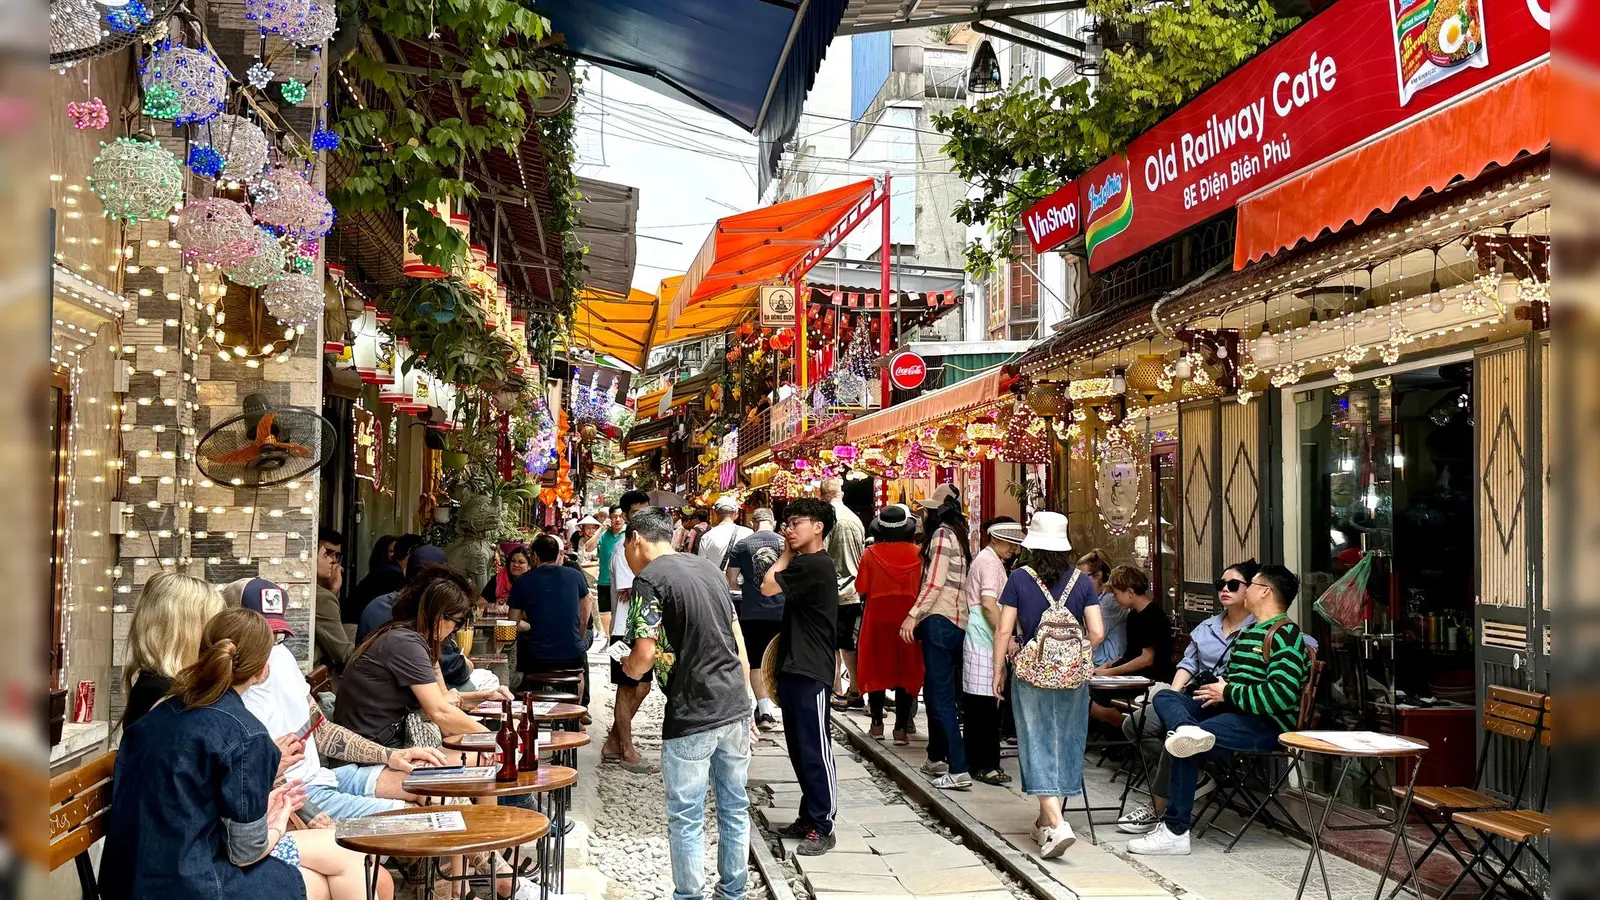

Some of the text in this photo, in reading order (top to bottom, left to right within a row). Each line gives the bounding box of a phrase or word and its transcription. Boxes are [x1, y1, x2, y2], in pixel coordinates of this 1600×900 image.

[1144, 142, 1178, 192] Old
[1180, 96, 1265, 172] Railway
[1272, 51, 1337, 117] Cafe
[1087, 172, 1122, 223] Indomie
[1183, 133, 1291, 209] 8E Điện Biên Phủ
[1028, 202, 1076, 244] VinShop
